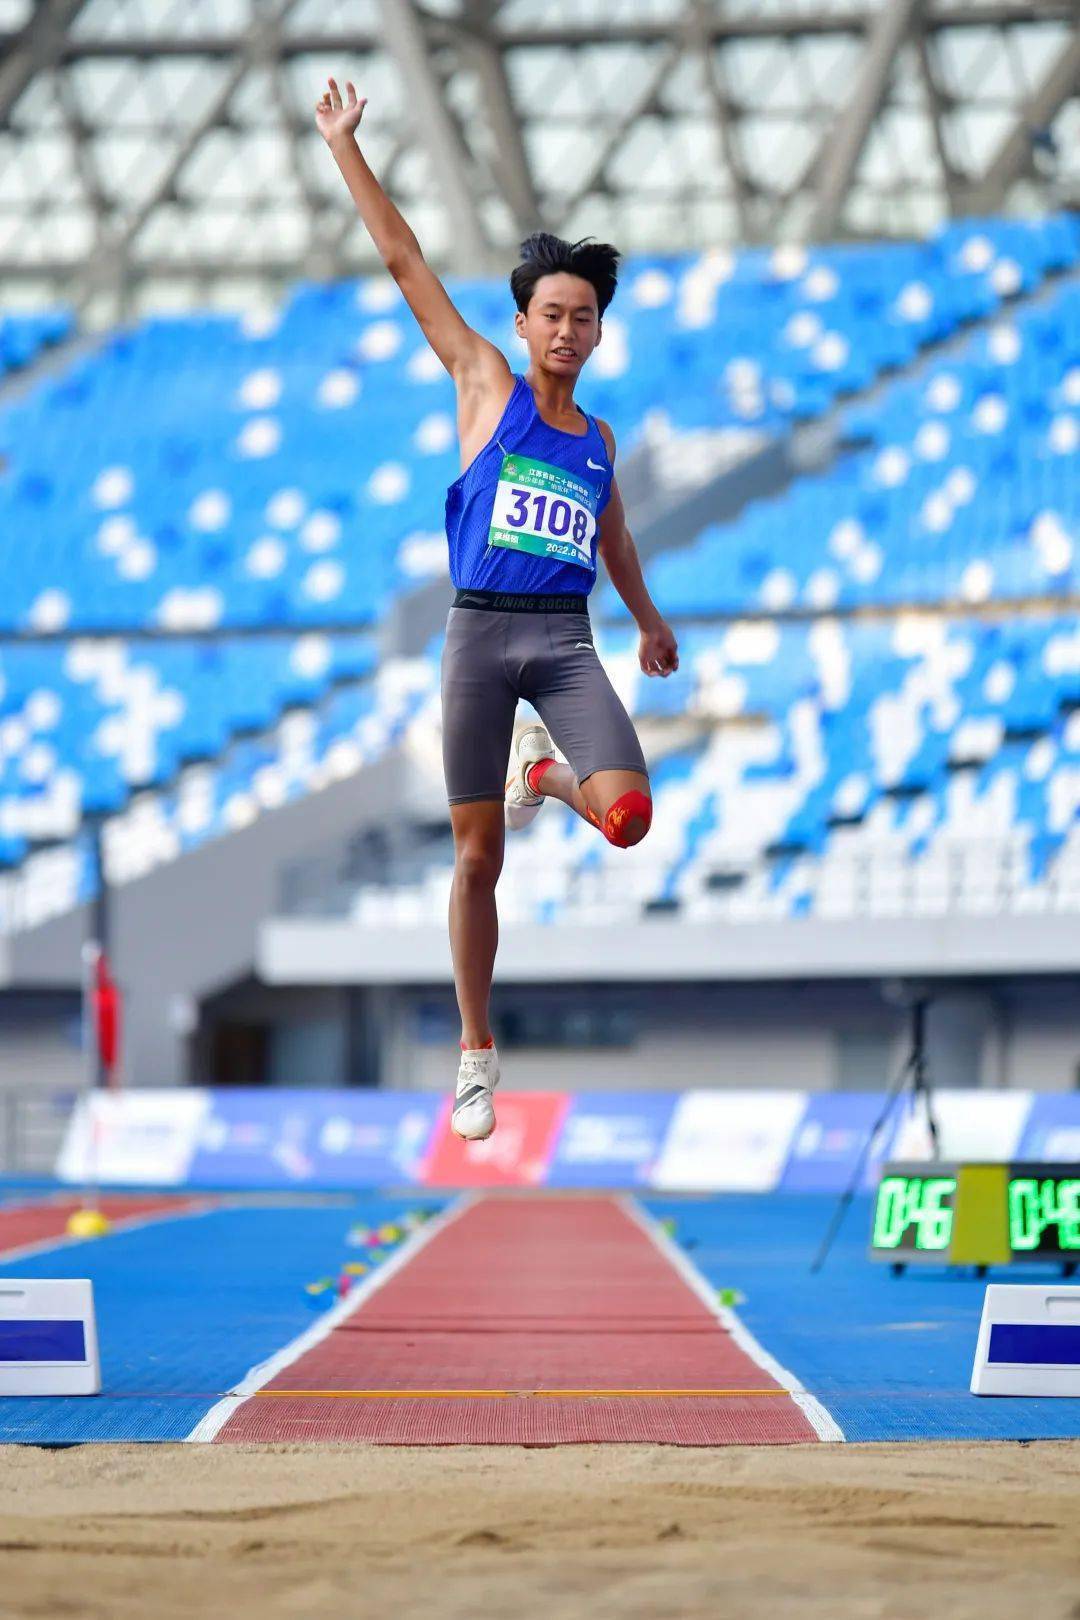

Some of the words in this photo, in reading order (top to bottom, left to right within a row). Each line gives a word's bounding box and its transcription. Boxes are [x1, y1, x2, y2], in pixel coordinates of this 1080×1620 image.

[506, 488, 588, 546] 3108
[545, 542, 577, 557] 2022.8
[493, 596, 535, 609] LINING
[872, 1177, 957, 1250] 046
